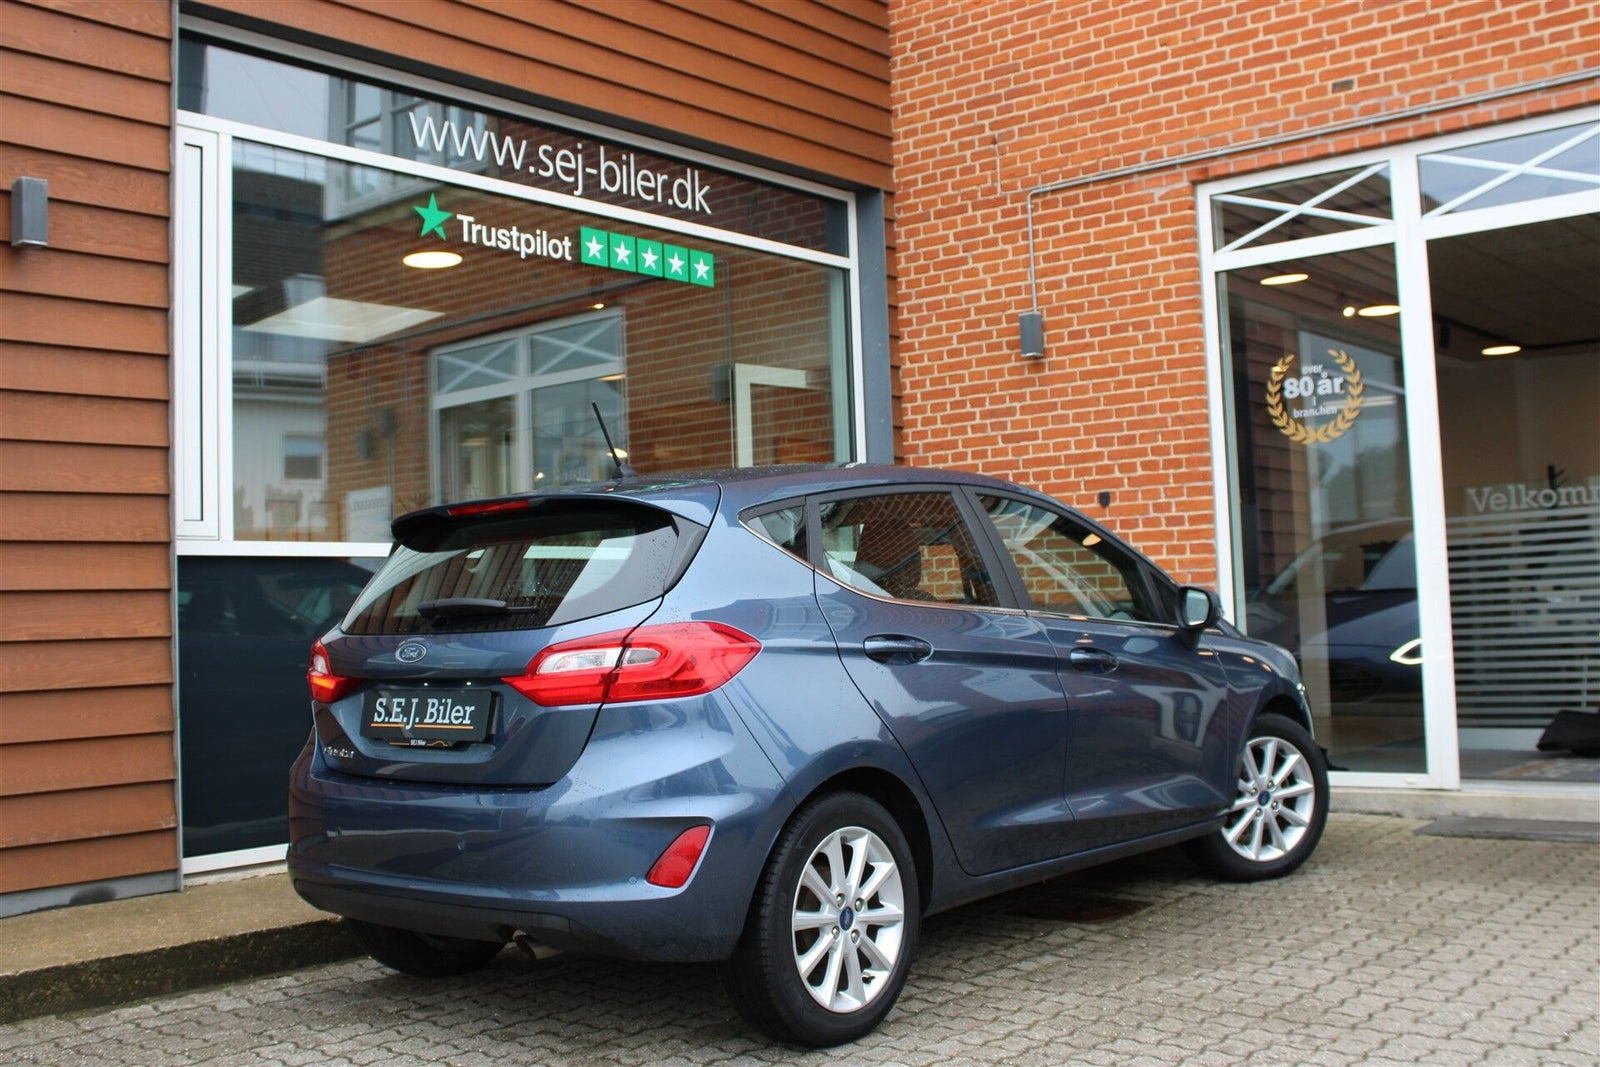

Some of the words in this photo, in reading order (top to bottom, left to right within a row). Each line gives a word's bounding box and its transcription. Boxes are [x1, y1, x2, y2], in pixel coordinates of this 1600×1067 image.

[408, 111, 713, 214] www.sej-biler.dk
[457, 213, 573, 261] Trustpilot
[1283, 376, 1314, 399] 80
[1317, 372, 1345, 394] år
[373, 697, 419, 730] S.E.J.
[423, 698, 475, 724] Biler
